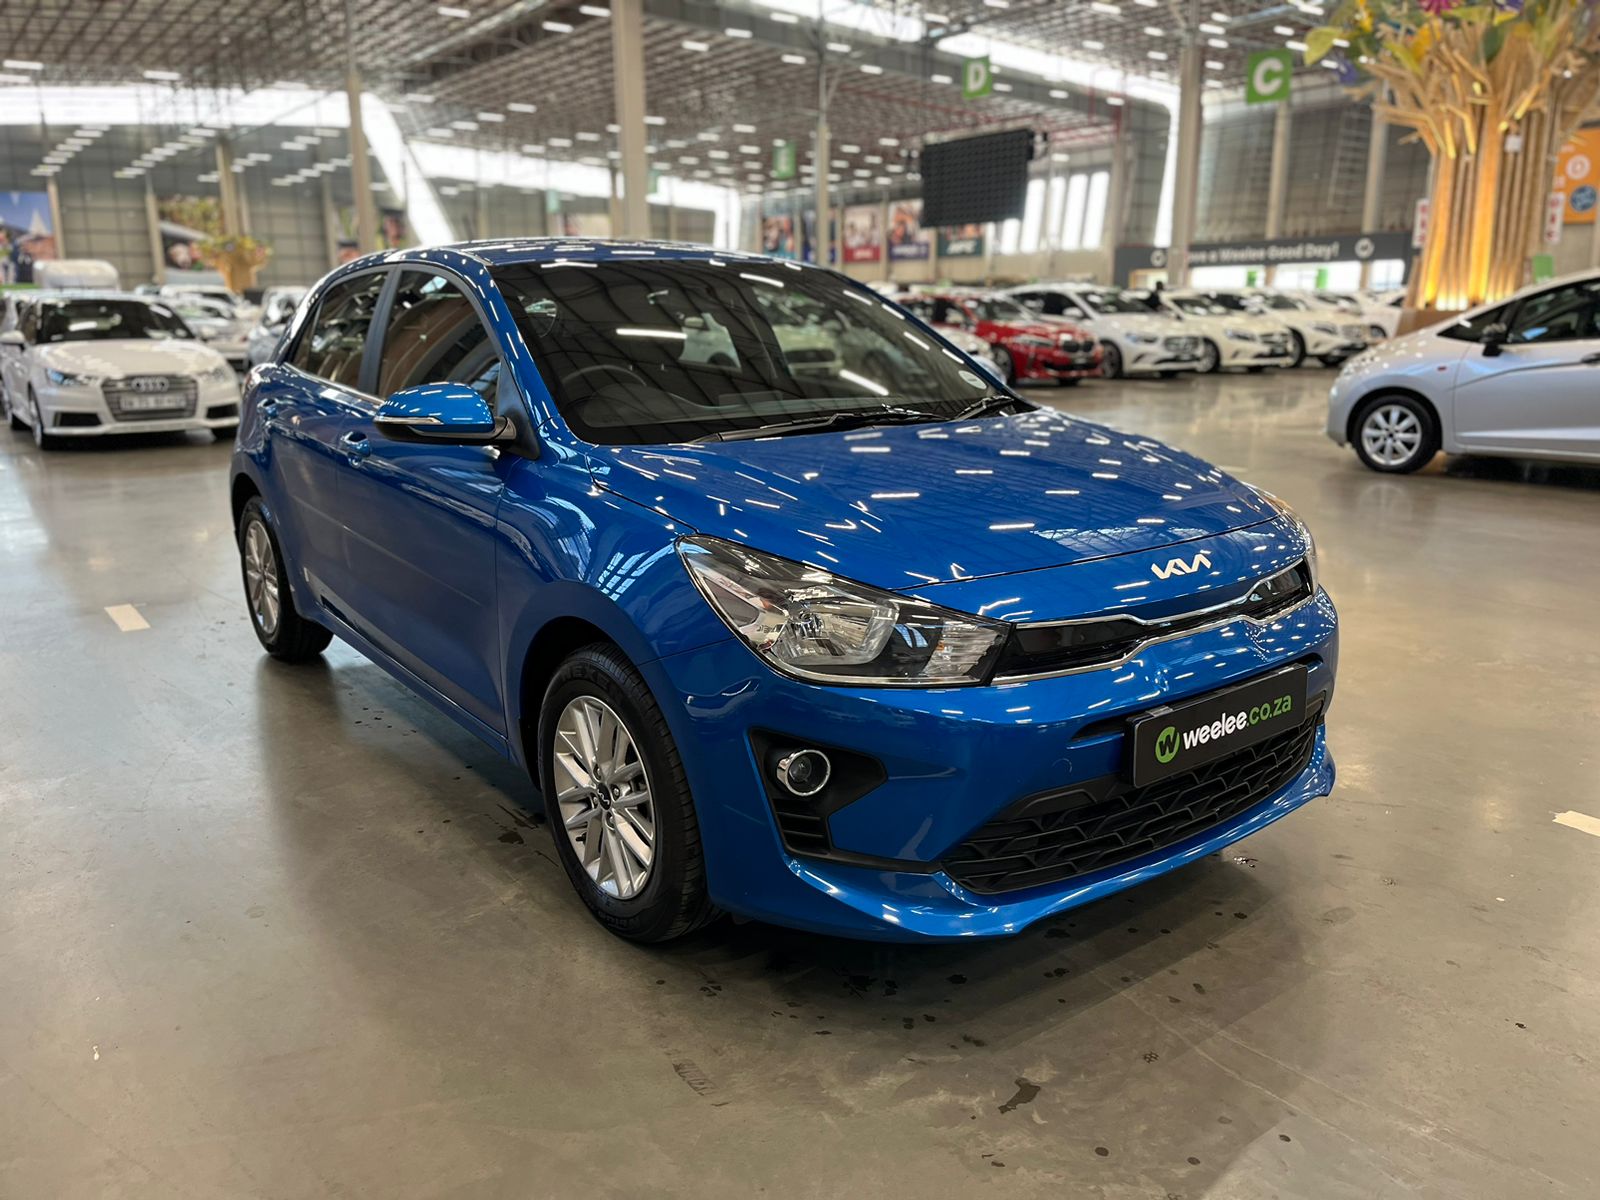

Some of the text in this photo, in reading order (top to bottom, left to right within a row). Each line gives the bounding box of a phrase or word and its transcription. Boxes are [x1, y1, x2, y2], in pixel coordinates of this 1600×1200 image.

[966, 61, 986, 92] D
[1253, 57, 1284, 95] C
[1266, 242, 1303, 260] Good
[1304, 240, 1340, 260] Day!
[1183, 695, 1292, 750] weelee.co.za
